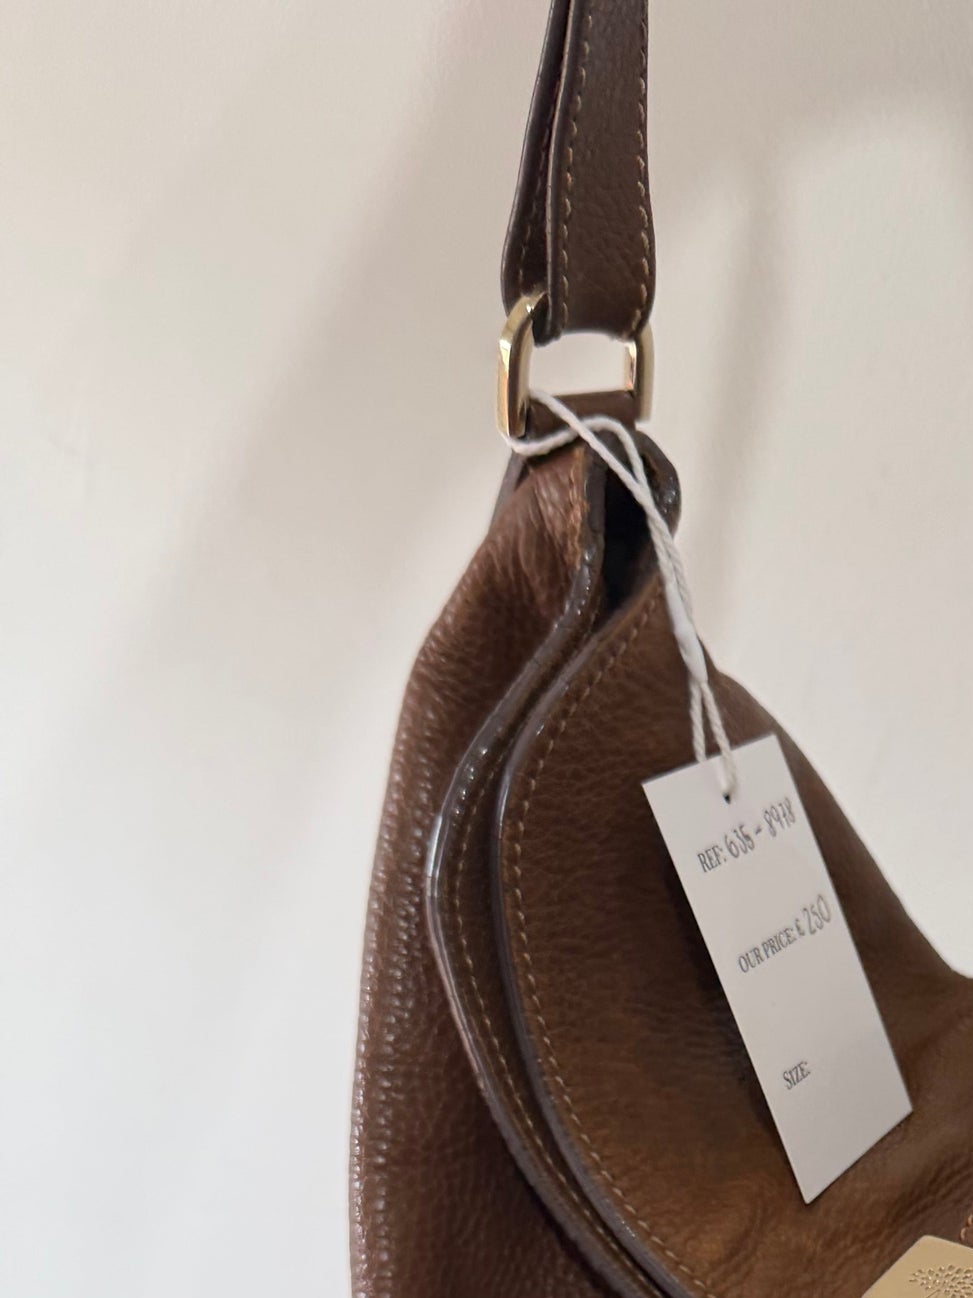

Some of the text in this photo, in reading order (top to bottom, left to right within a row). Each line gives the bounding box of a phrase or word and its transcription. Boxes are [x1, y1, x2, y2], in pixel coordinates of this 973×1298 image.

[697, 844, 726, 873] REF:
[738, 946, 765, 974] OUR
[761, 927, 798, 960] PRICE:
[782, 1060, 811, 1091] SIZE:
